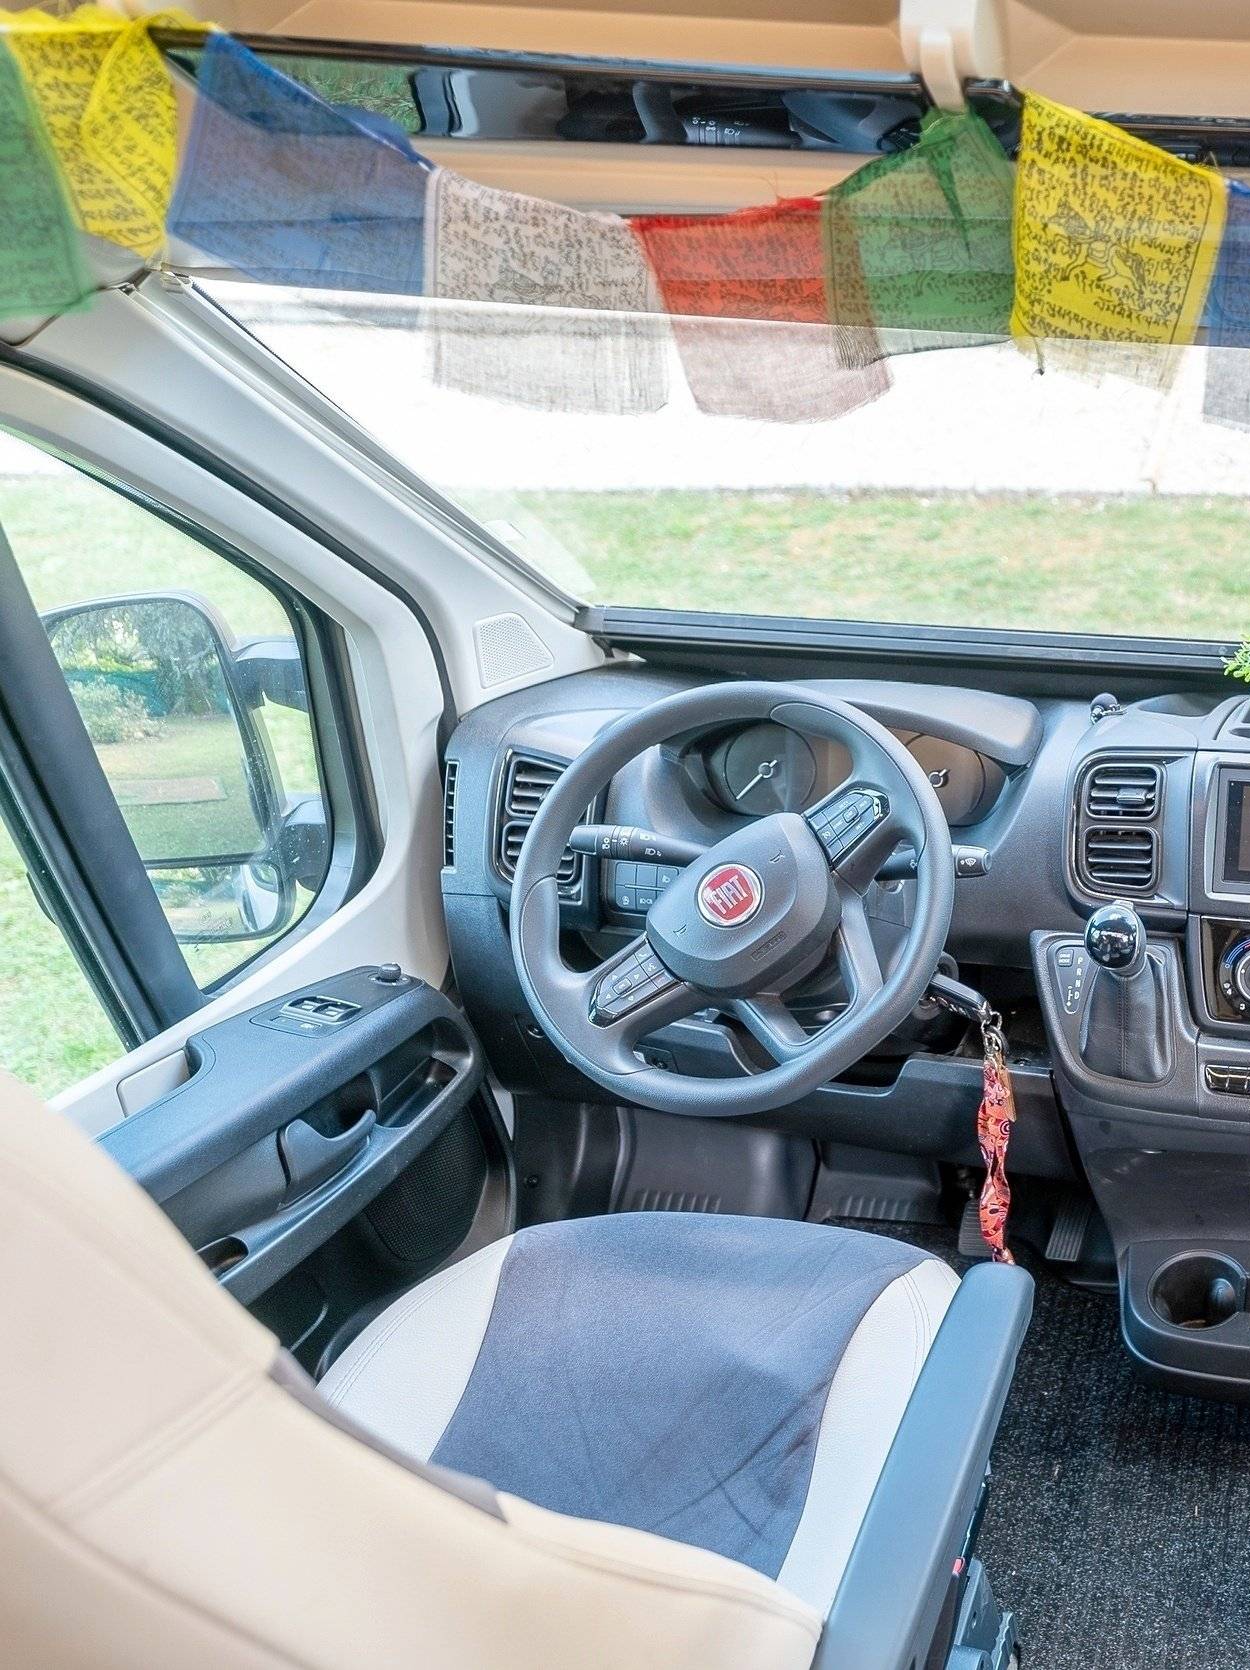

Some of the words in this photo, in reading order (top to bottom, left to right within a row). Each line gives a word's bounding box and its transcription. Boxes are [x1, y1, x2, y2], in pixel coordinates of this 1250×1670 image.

[711, 874, 749, 915] FIAT
[1077, 956, 1084, 965] P
[1076, 967, 1083, 976] R
[1075, 979, 1081, 988] N
[1074, 990, 1080, 1000] D
[1239, 1003, 1246, 1011] 3
